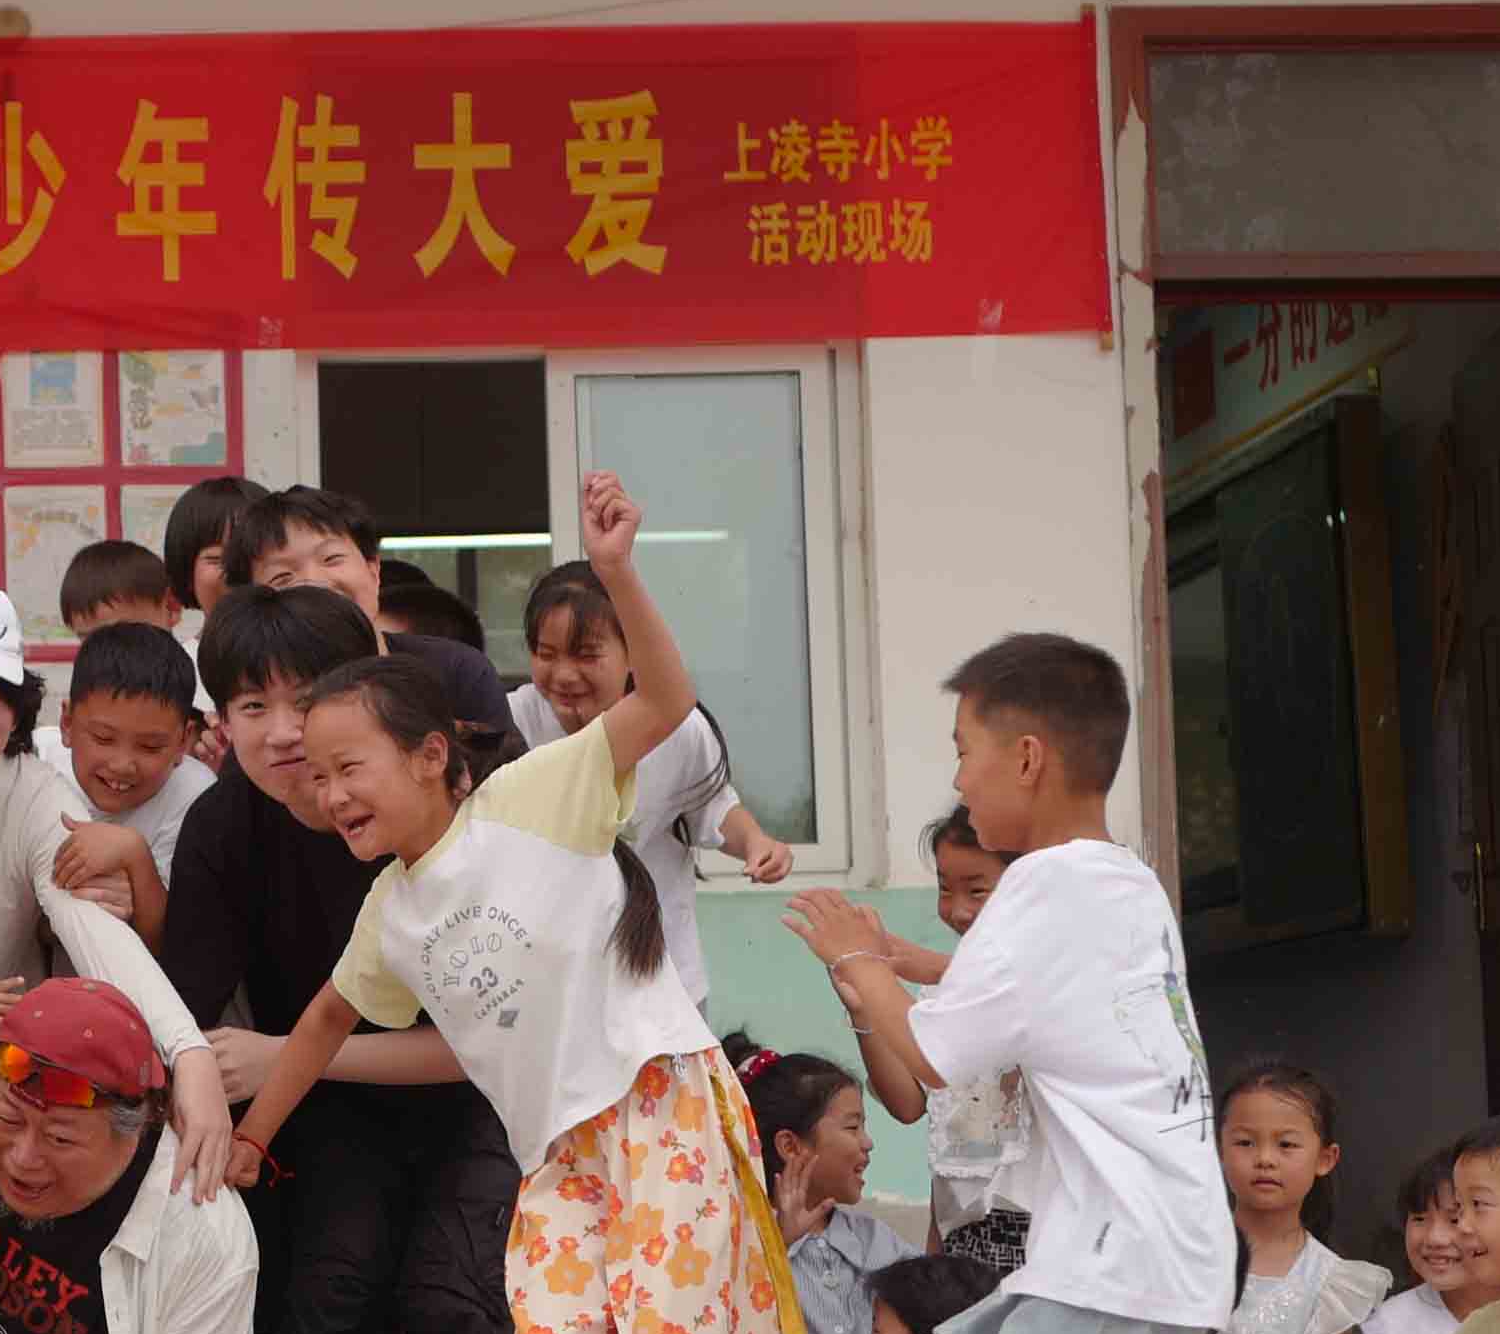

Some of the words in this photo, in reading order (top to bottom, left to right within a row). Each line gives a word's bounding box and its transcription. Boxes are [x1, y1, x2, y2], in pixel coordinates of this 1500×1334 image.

[724, 116, 953, 183] 上凌寺小学
[746, 199, 934, 265] 活动现场
[445, 906, 481, 929] LIVE
[487, 906, 528, 940] ONCE
